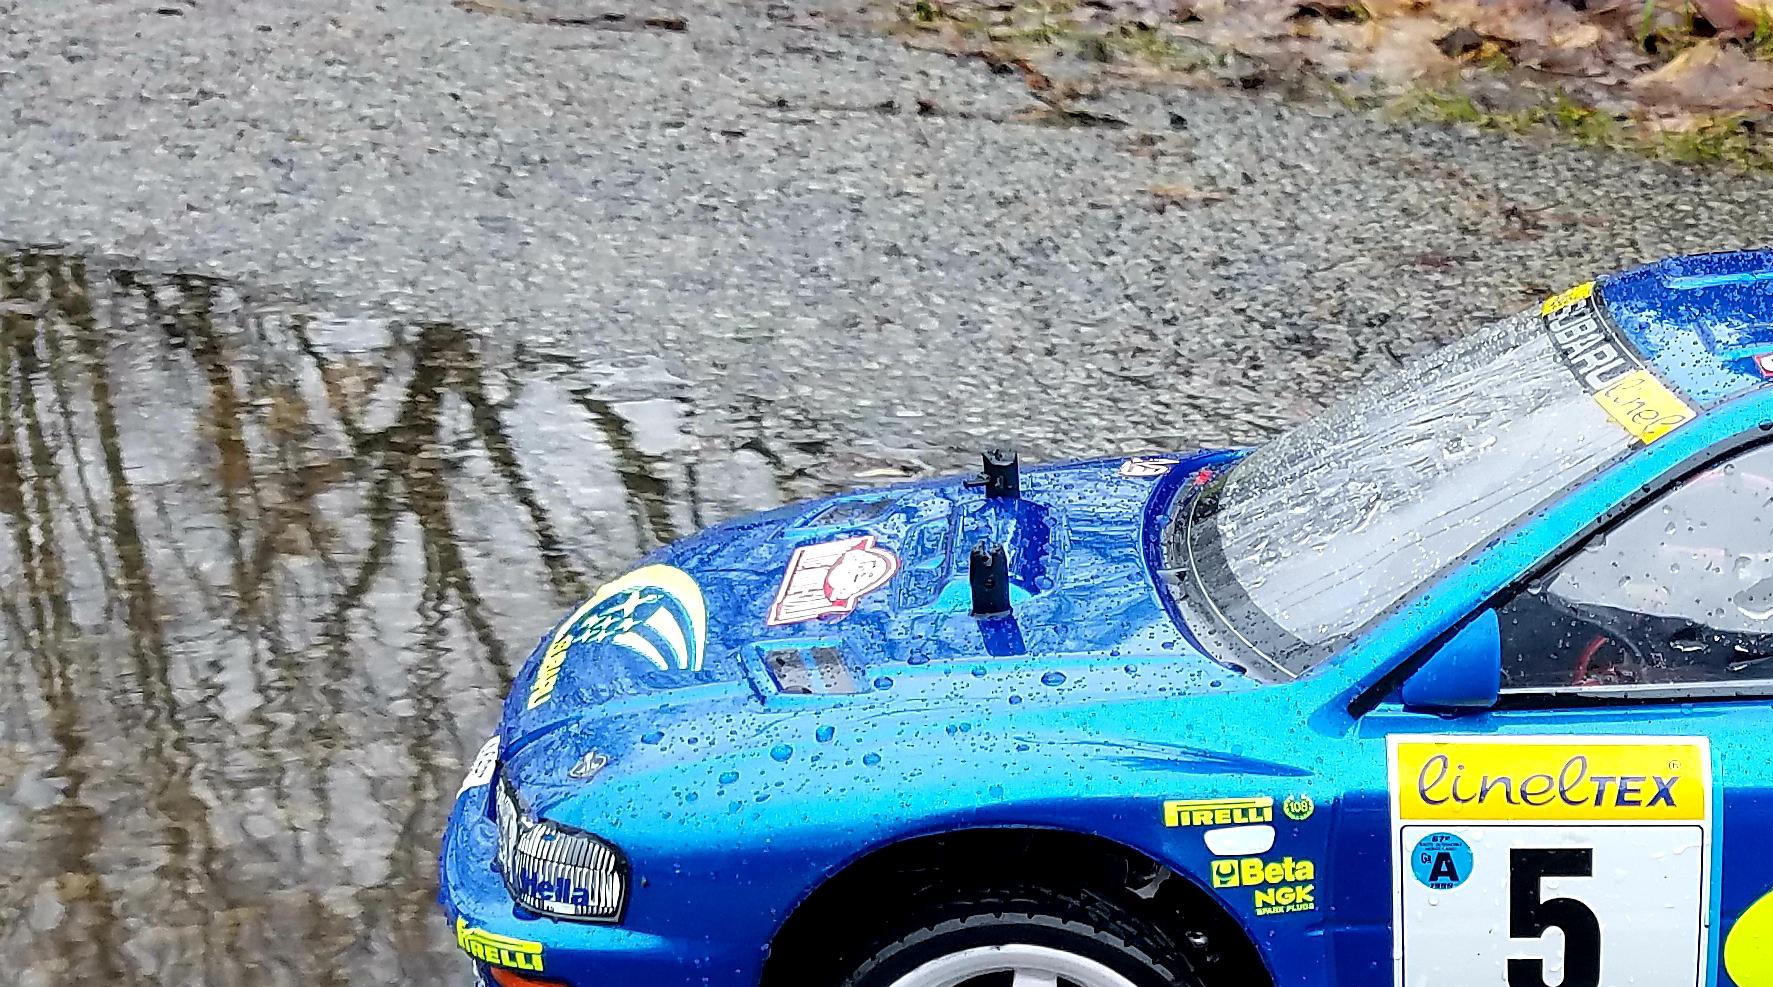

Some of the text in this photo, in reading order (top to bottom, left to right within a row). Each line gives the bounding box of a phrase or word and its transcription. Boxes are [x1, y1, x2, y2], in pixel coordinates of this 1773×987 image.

[1163, 796, 1274, 827] PIRELLI
[1241, 857, 1314, 886] Beta
[1429, 852, 1460, 882] A
[521, 865, 589, 904] Hella
[1255, 884, 1315, 907] NGK
[456, 915, 544, 971] PIRELLI
